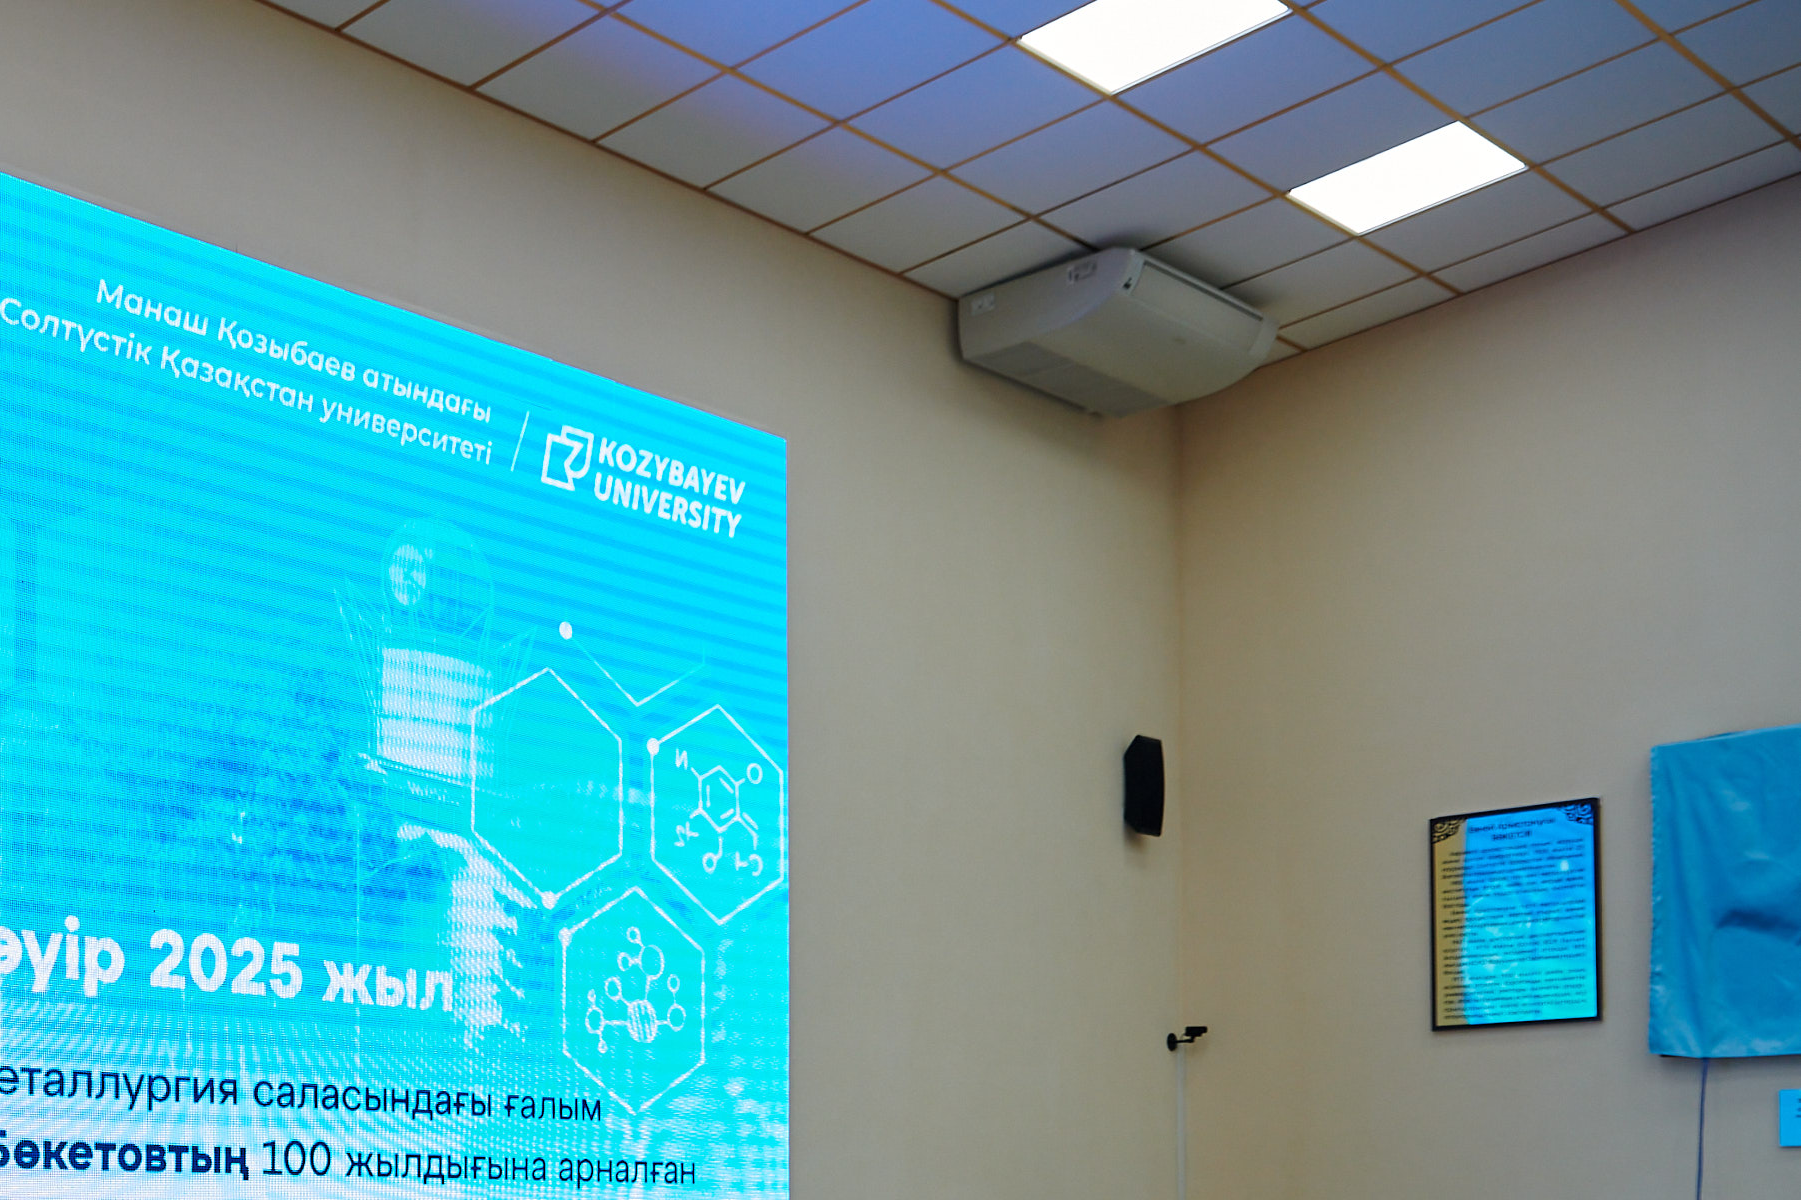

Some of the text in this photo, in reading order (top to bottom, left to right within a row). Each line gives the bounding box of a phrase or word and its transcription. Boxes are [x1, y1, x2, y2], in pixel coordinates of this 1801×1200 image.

[0, 296, 494, 467] Солтүстік Қазақстан университеті
[95, 278, 492, 426] Манаш Қозыбаев атындағы
[593, 472, 742, 540] UNIVERSITY
[598, 436, 746, 506] KOZYBAYEV
[149, 928, 303, 999] 2025
[322, 957, 455, 1012] жыл
[253, 1077, 492, 1121] саласындағы
[504, 1092, 602, 1121] ғалым
[261, 1139, 332, 1178] 100
[345, 1149, 547, 1185] жылдығына
[557, 1152, 697, 1187] арналған
